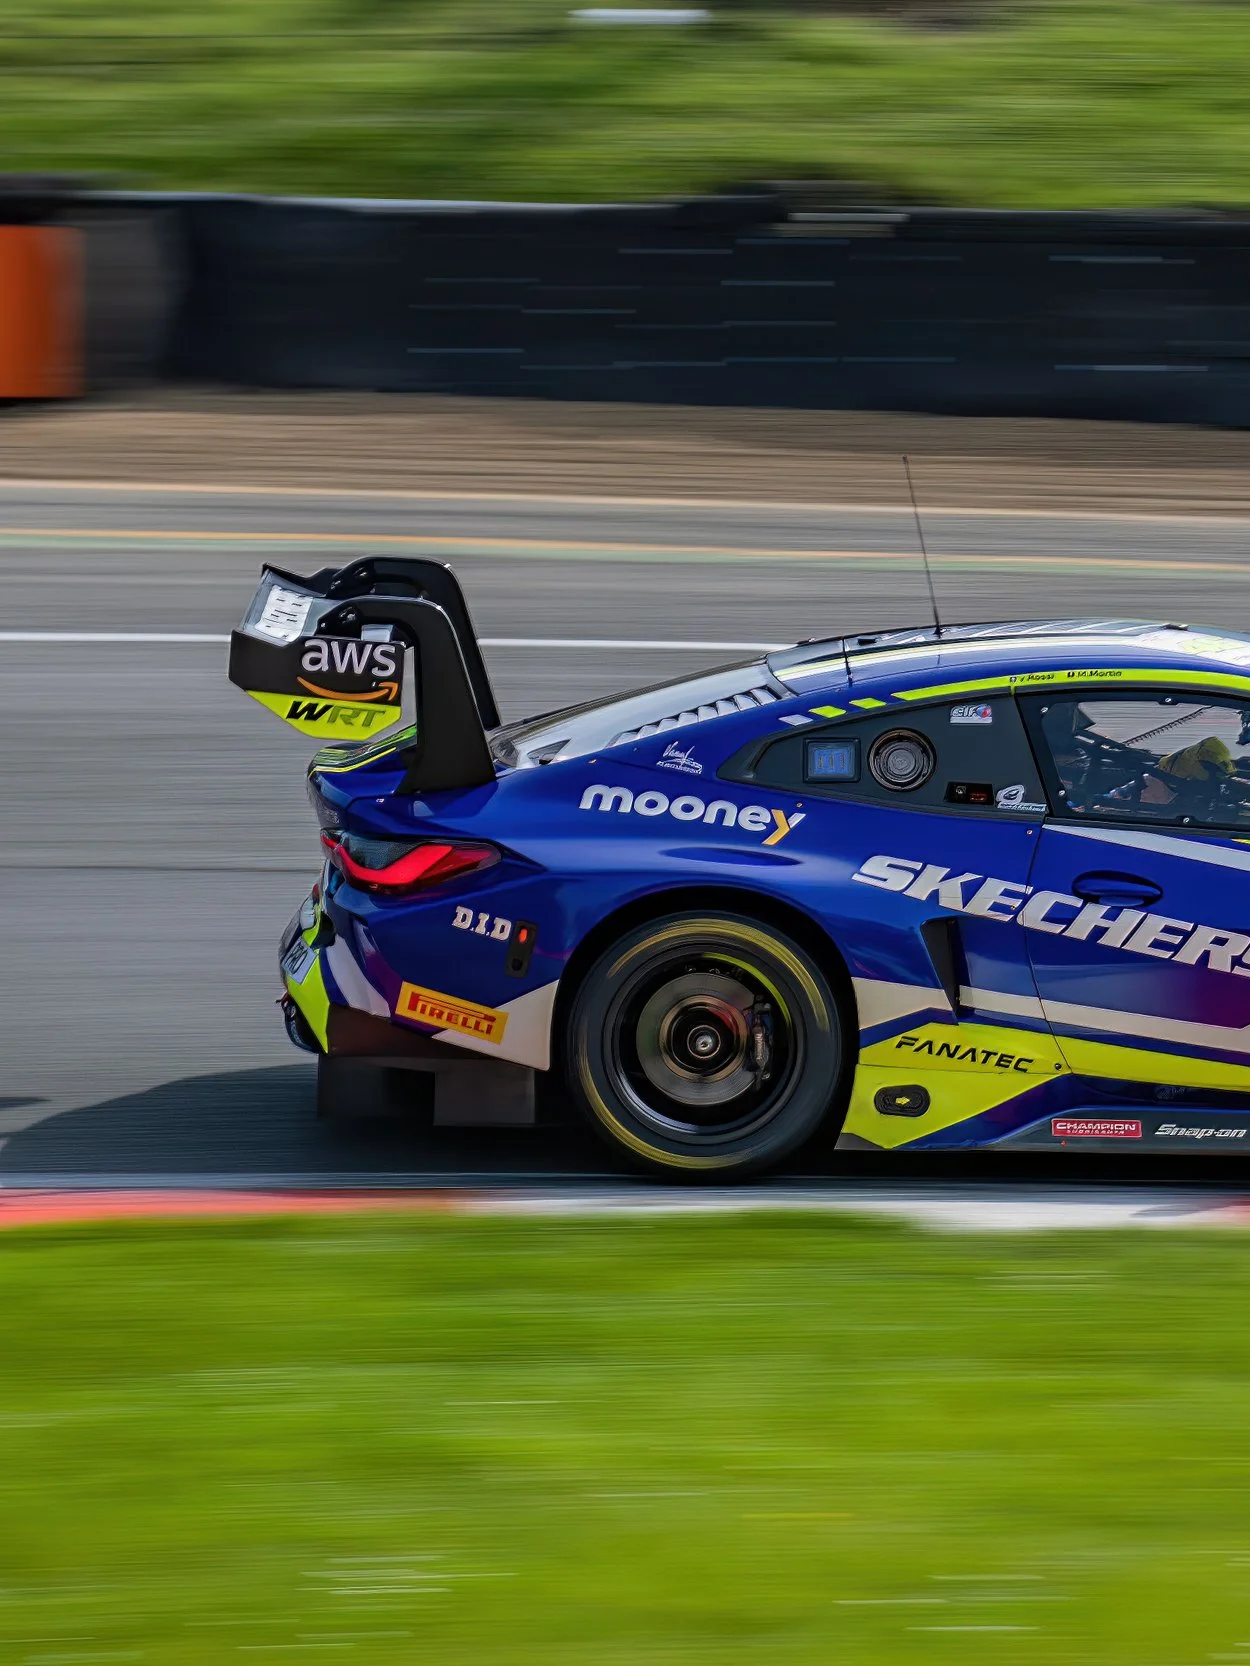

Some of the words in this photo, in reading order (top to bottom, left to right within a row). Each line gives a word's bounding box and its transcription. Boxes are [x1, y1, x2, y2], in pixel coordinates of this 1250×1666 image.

[301, 638, 397, 677] aws
[285, 701, 387, 728] WRT
[580, 784, 806, 845] mooney
[408, 991, 497, 1035] PIRELLI
[895, 1036, 1035, 1072] FANATEC
[1056, 1122, 1136, 1131] CHAMPION
[1154, 1123, 1248, 1139] Snap-on
